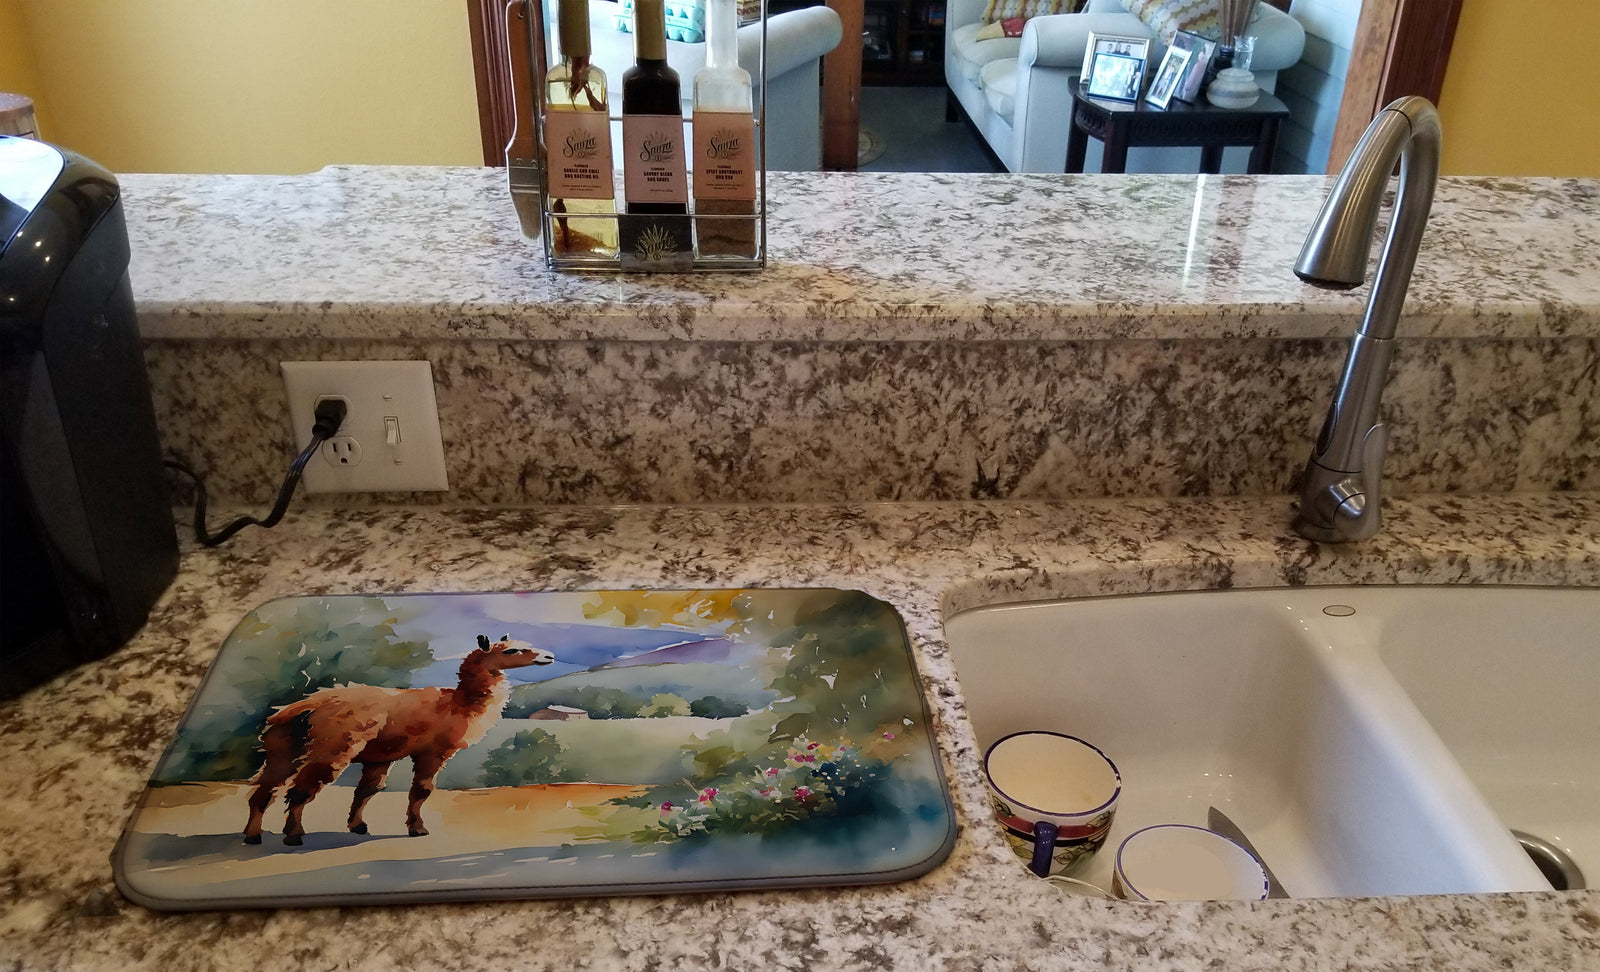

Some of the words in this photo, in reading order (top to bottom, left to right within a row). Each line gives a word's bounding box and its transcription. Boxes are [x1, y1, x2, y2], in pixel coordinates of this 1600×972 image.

[562, 136, 597, 158] Sauza
[640, 140, 673, 162] Sauza
[706, 137, 740, 159] Sauza
